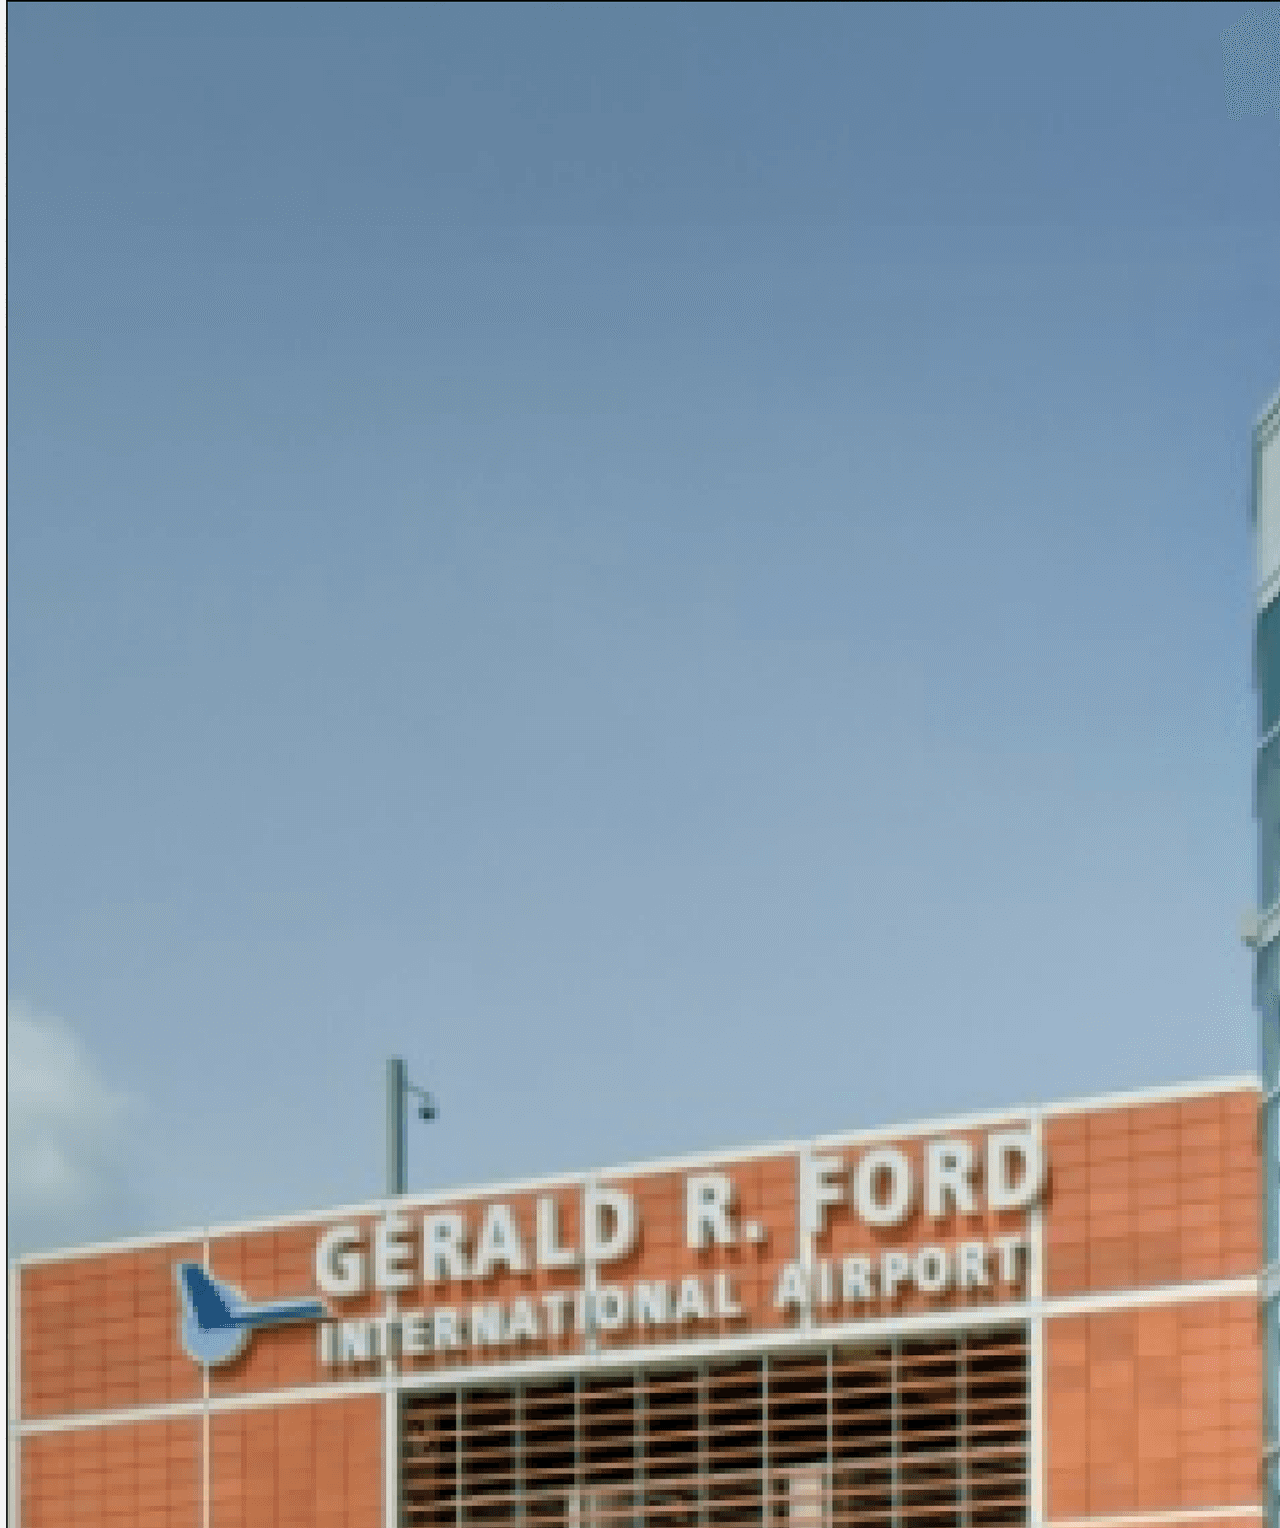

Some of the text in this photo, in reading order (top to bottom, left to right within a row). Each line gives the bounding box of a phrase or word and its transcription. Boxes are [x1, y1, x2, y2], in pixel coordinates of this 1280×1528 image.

[315, 1131, 1044, 1296] GERALD R. FORD
[320, 1236, 1030, 1364] INTERNATIONAL AIRPORT
